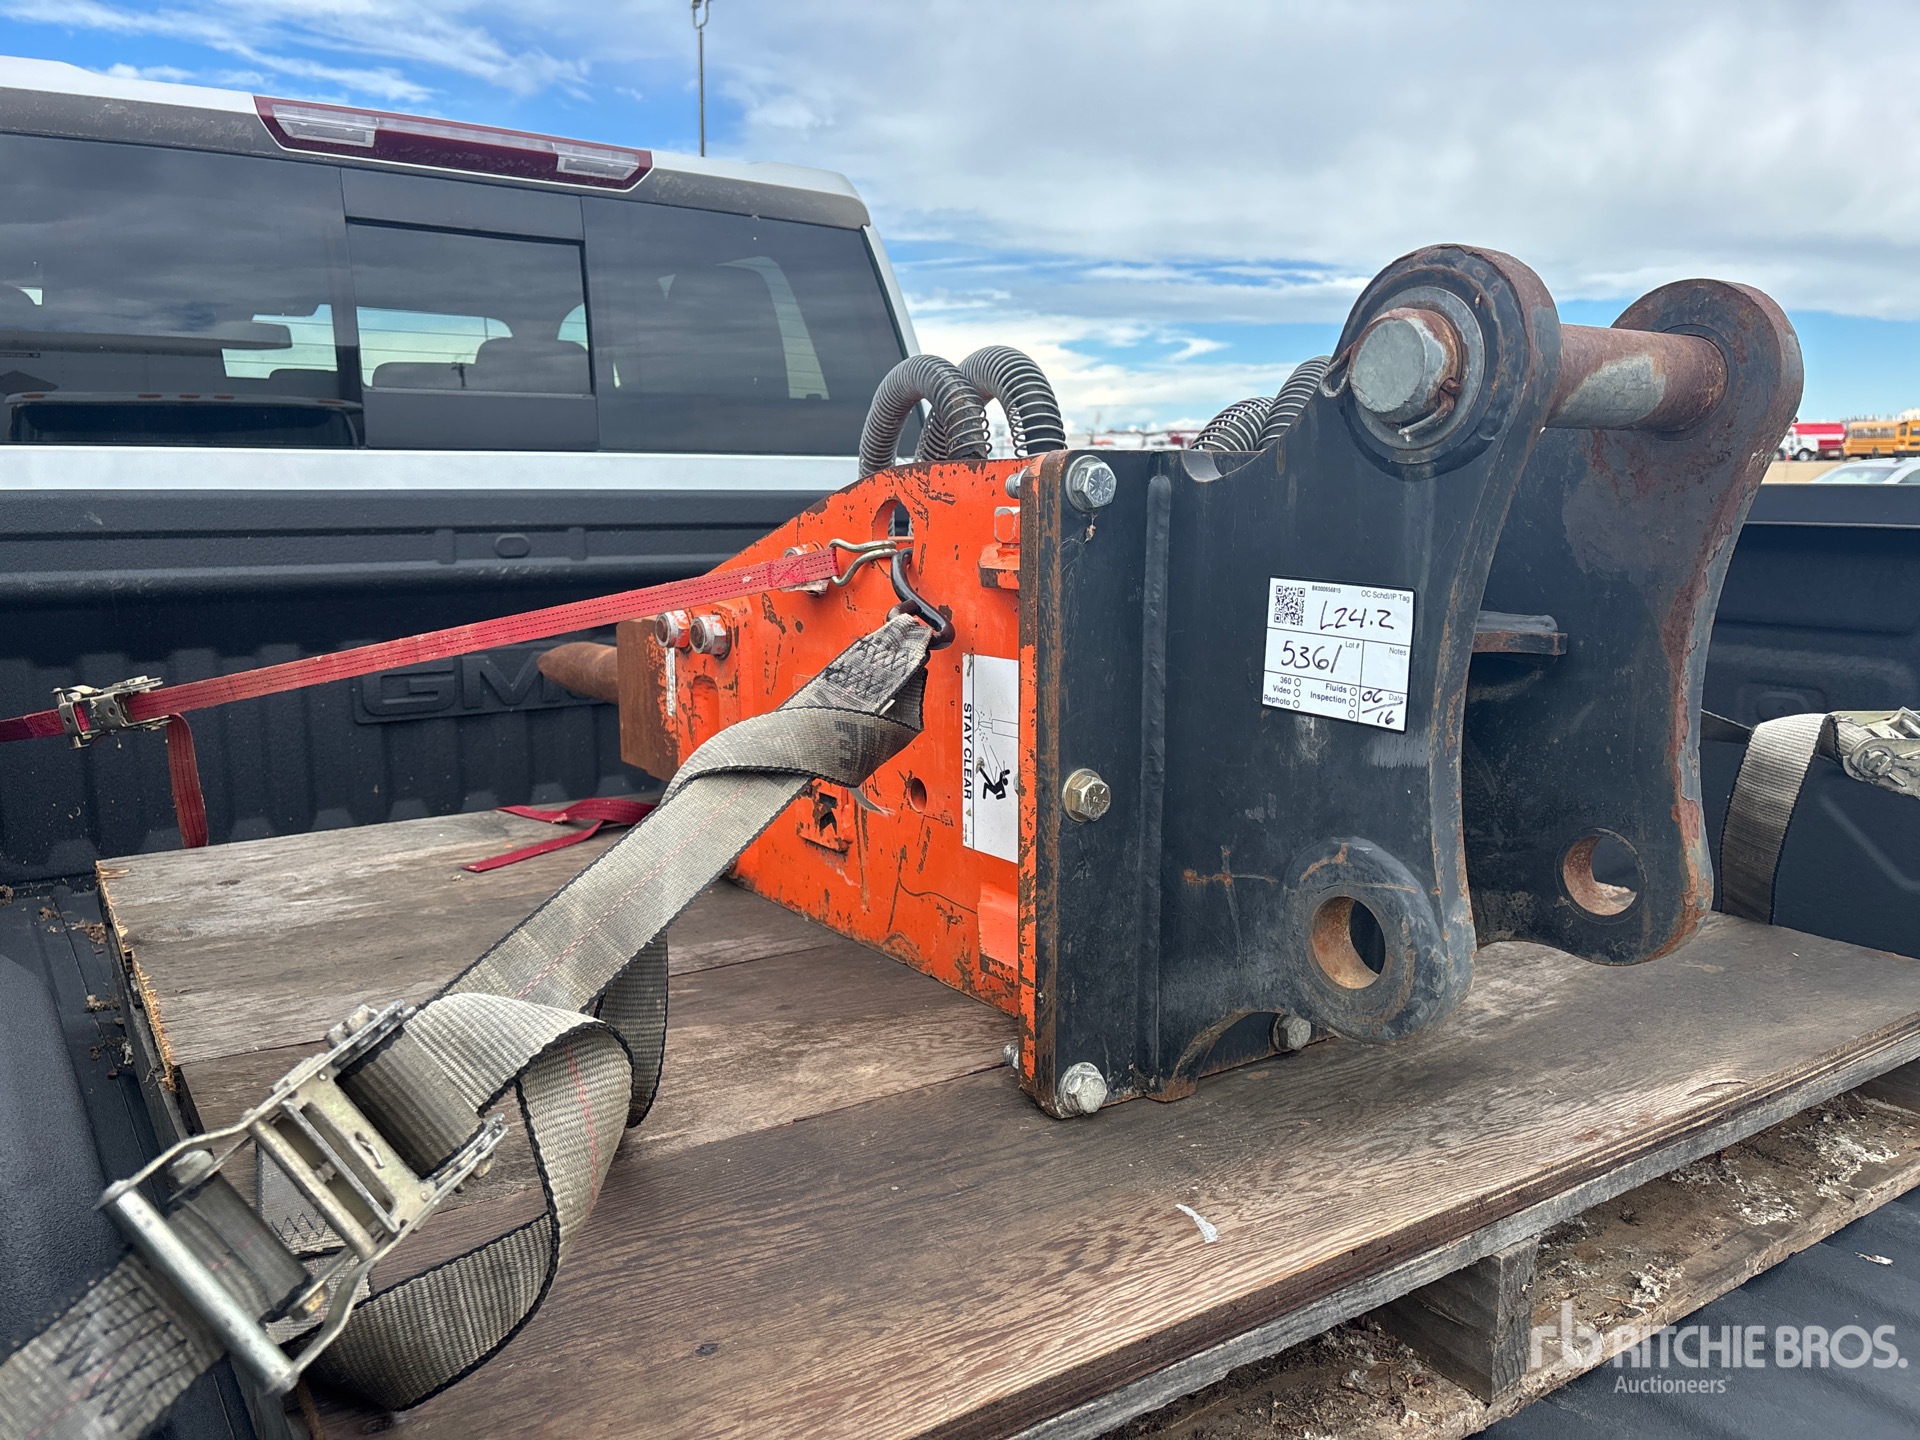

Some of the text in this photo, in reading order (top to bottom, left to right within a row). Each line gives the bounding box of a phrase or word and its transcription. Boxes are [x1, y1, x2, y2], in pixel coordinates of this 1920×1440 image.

[1361, 590, 1371, 598] OC
[1399, 594, 1410, 603] Tag
[1389, 647, 1407, 656] Notes
[1273, 685, 1291, 695] Video
[1325, 683, 1347, 693] Fluids
[1264, 695, 1290, 706] Rephoto
[1310, 691, 1347, 705] Inspection
[963, 702, 973, 800] STAY CLEAR
